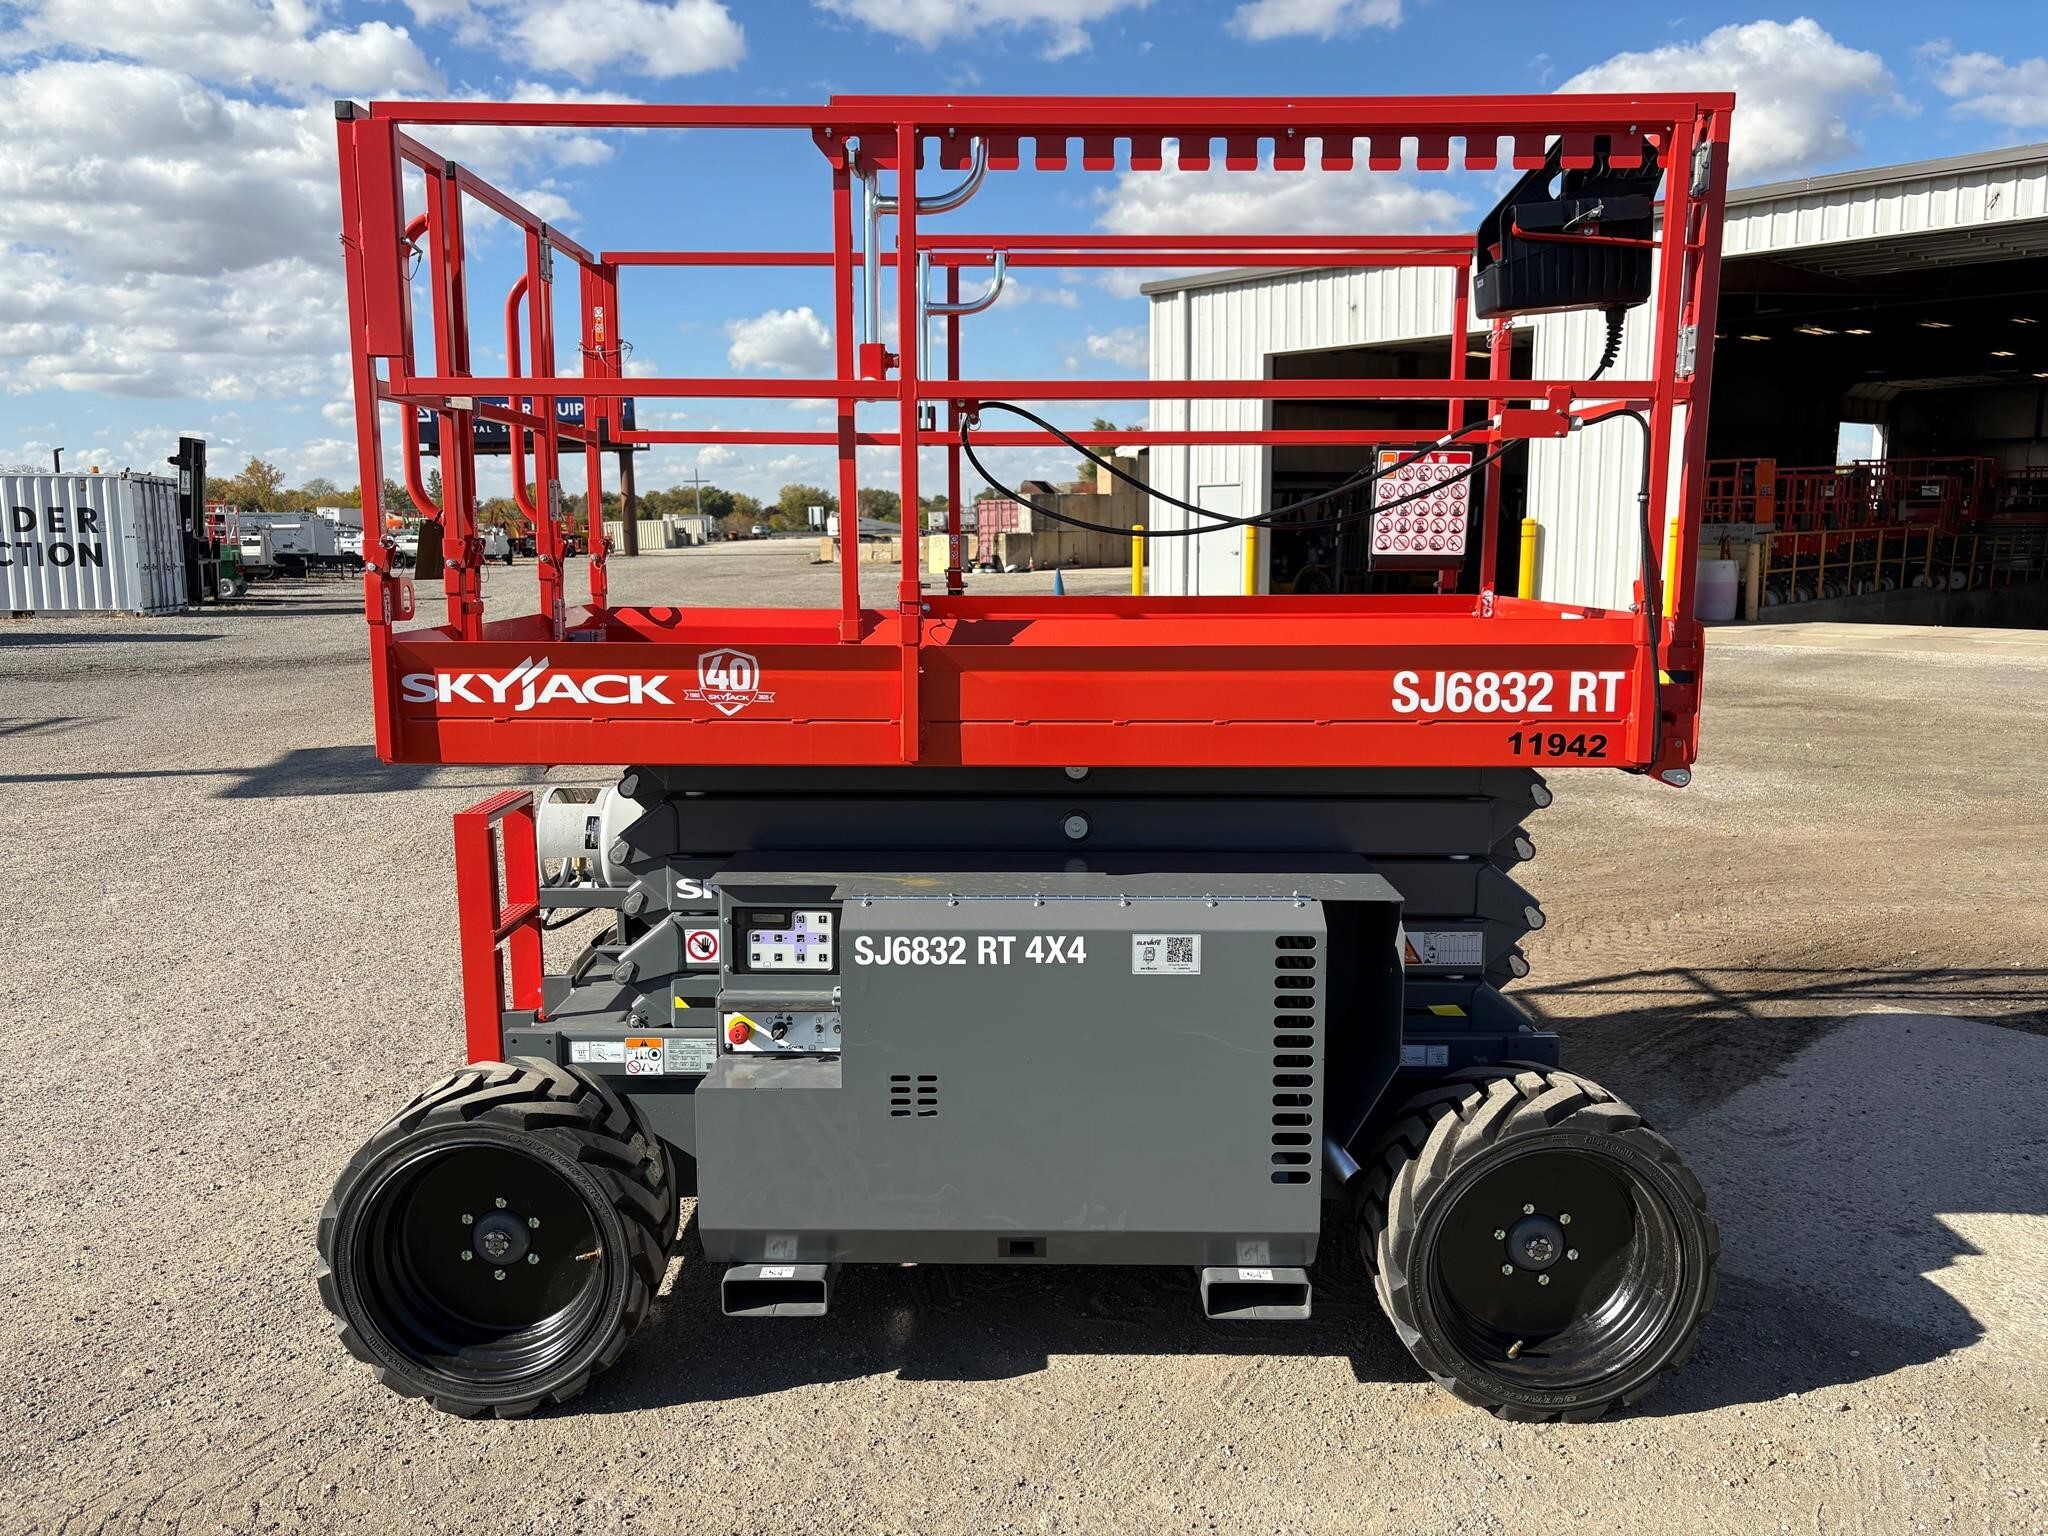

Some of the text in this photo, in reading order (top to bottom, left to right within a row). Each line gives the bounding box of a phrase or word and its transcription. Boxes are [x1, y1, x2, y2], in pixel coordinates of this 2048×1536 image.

[401, 656, 675, 711] SKYJACK
[705, 655, 751, 690] 40
[1391, 671, 1626, 713] SJ6832 RT
[1507, 731, 1608, 758] 11942
[854, 935, 1087, 965] SJ6832 RT 4X4
